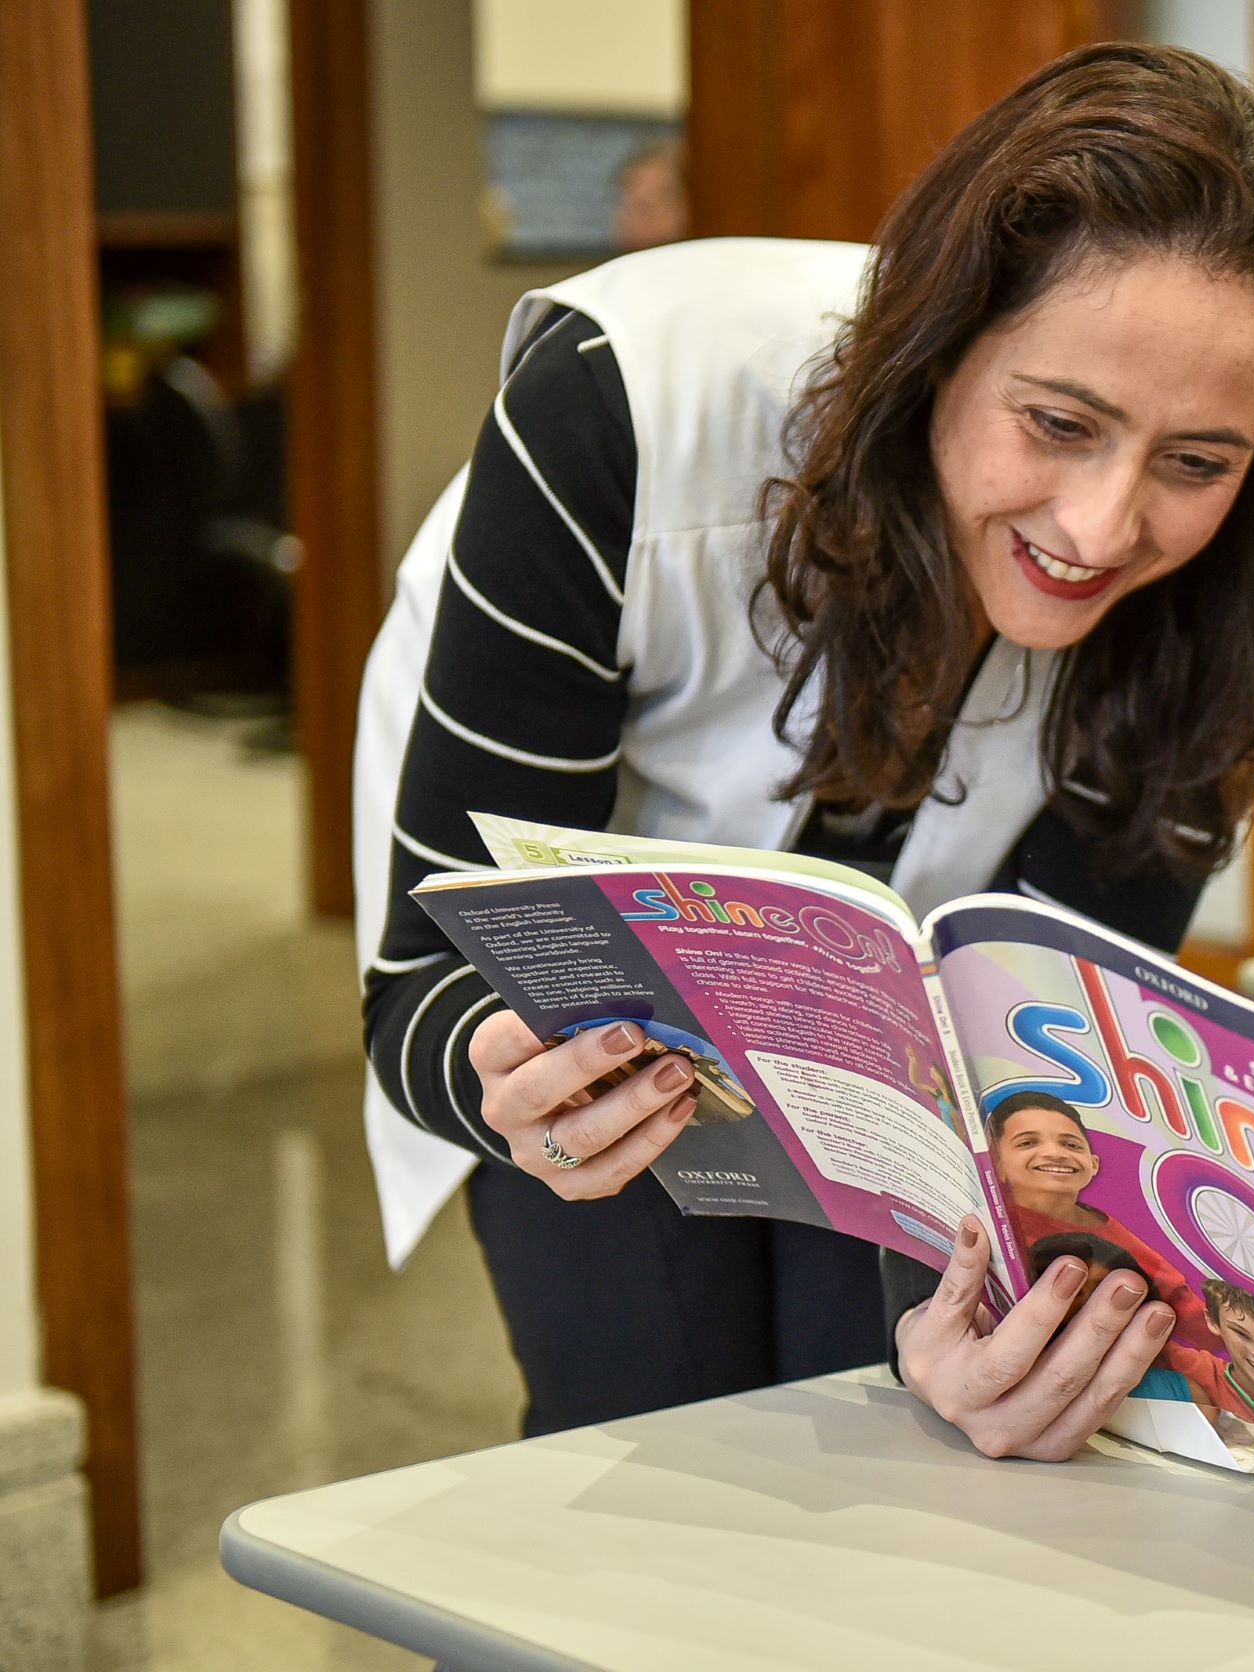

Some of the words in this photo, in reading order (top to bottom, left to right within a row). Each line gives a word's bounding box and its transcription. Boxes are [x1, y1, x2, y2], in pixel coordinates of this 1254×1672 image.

[525, 844, 543, 858] 5
[569, 854, 612, 864] Lesson
[458, 908, 491, 916] Oxford
[491, 905, 535, 913] University
[500, 920, 532, 928] English
[540, 926, 584, 935] University
[551, 932, 600, 940] committed
[799, 906, 902, 972] On!
[658, 925, 684, 933] Play
[685, 926, 733, 936] together,
[733, 929, 762, 938] learn
[762, 933, 809, 947] together,
[813, 945, 844, 965] shine
[490, 946, 537, 955] furthering
[522, 960, 577, 970] continuously
[511, 970, 549, 978] together
[517, 976, 557, 984] expertise
[551, 980, 593, 988] resources
[1134, 966, 1209, 1011] OXFORD
[1223, 1064, 1239, 1083] &
[677, 1170, 757, 1182] OXFORD
[736, 1181, 761, 1189] PRESS
